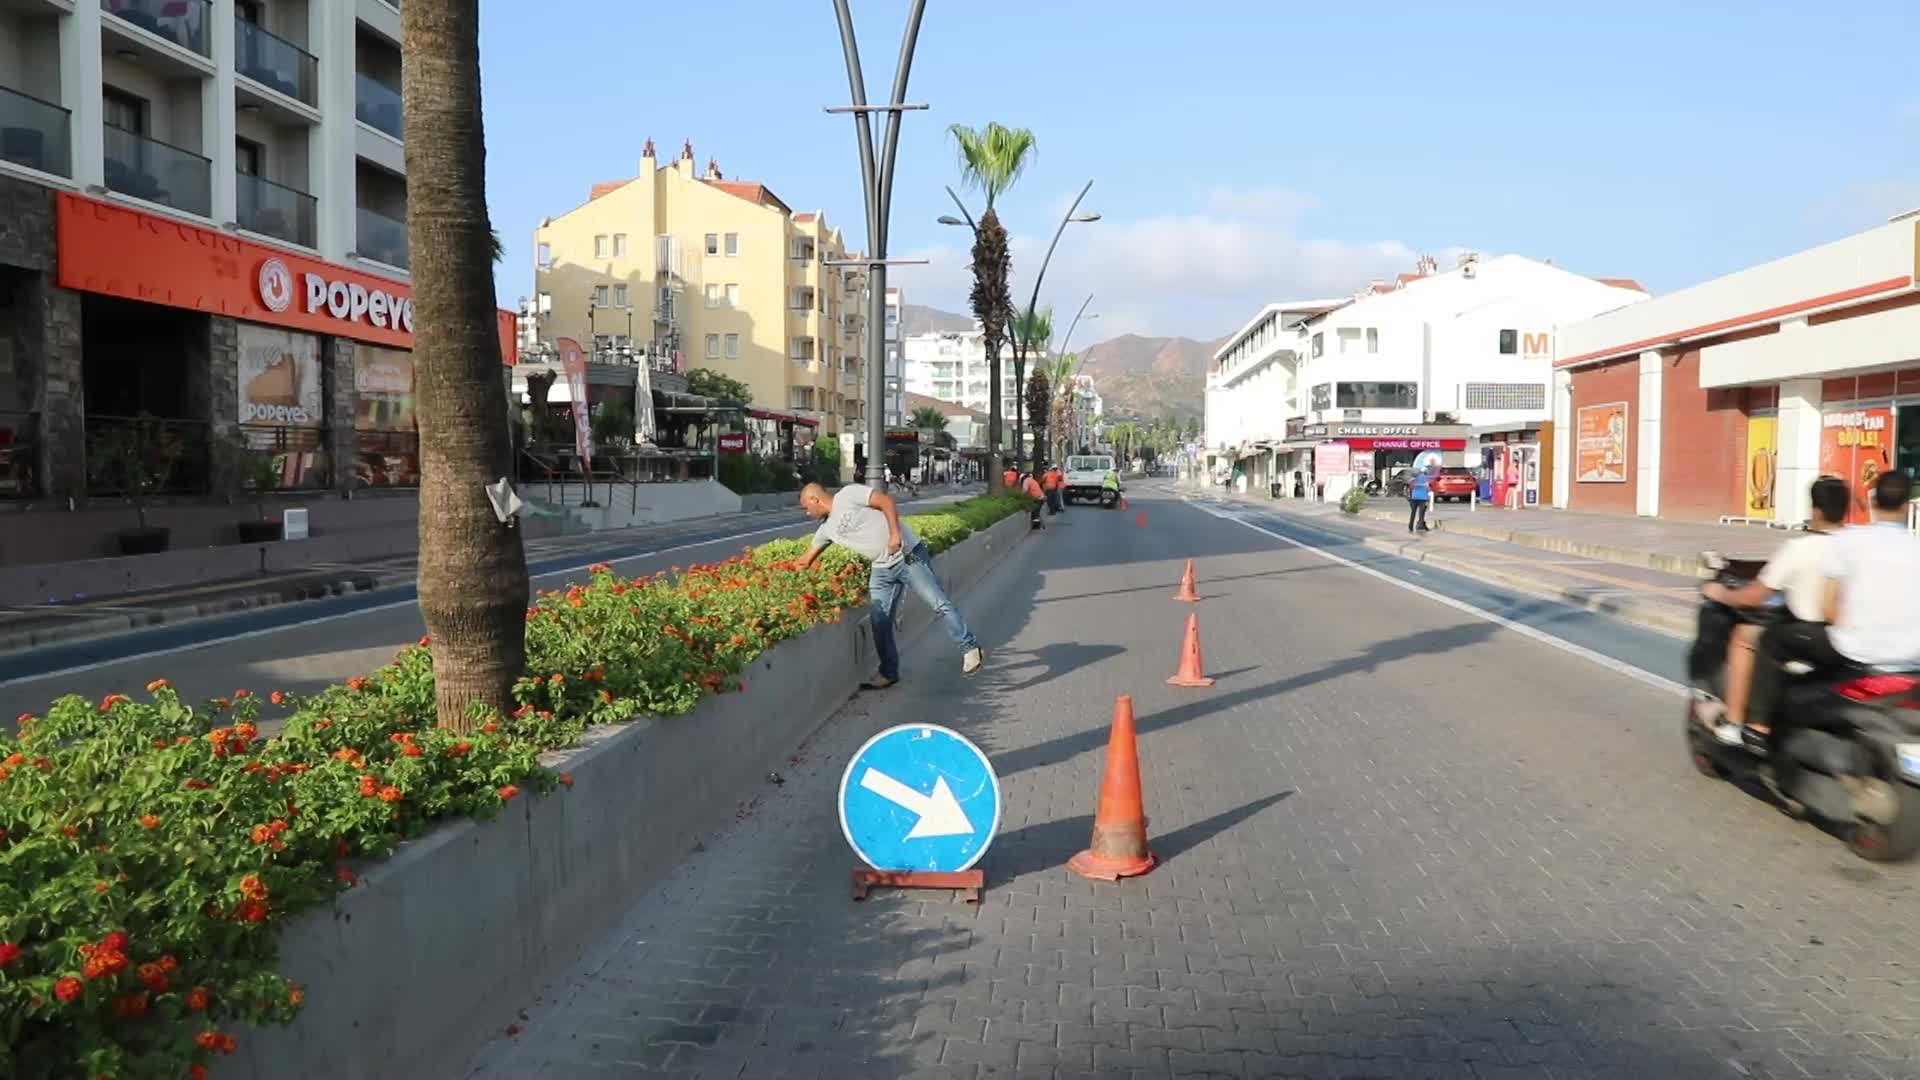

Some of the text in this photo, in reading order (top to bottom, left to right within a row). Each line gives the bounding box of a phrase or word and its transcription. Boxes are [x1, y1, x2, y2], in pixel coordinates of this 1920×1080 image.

[1523, 332, 1548, 354] M
[1337, 427, 1419, 435] CHANGE OFFICE
[1372, 440, 1441, 448] CHANGE OFFICE
